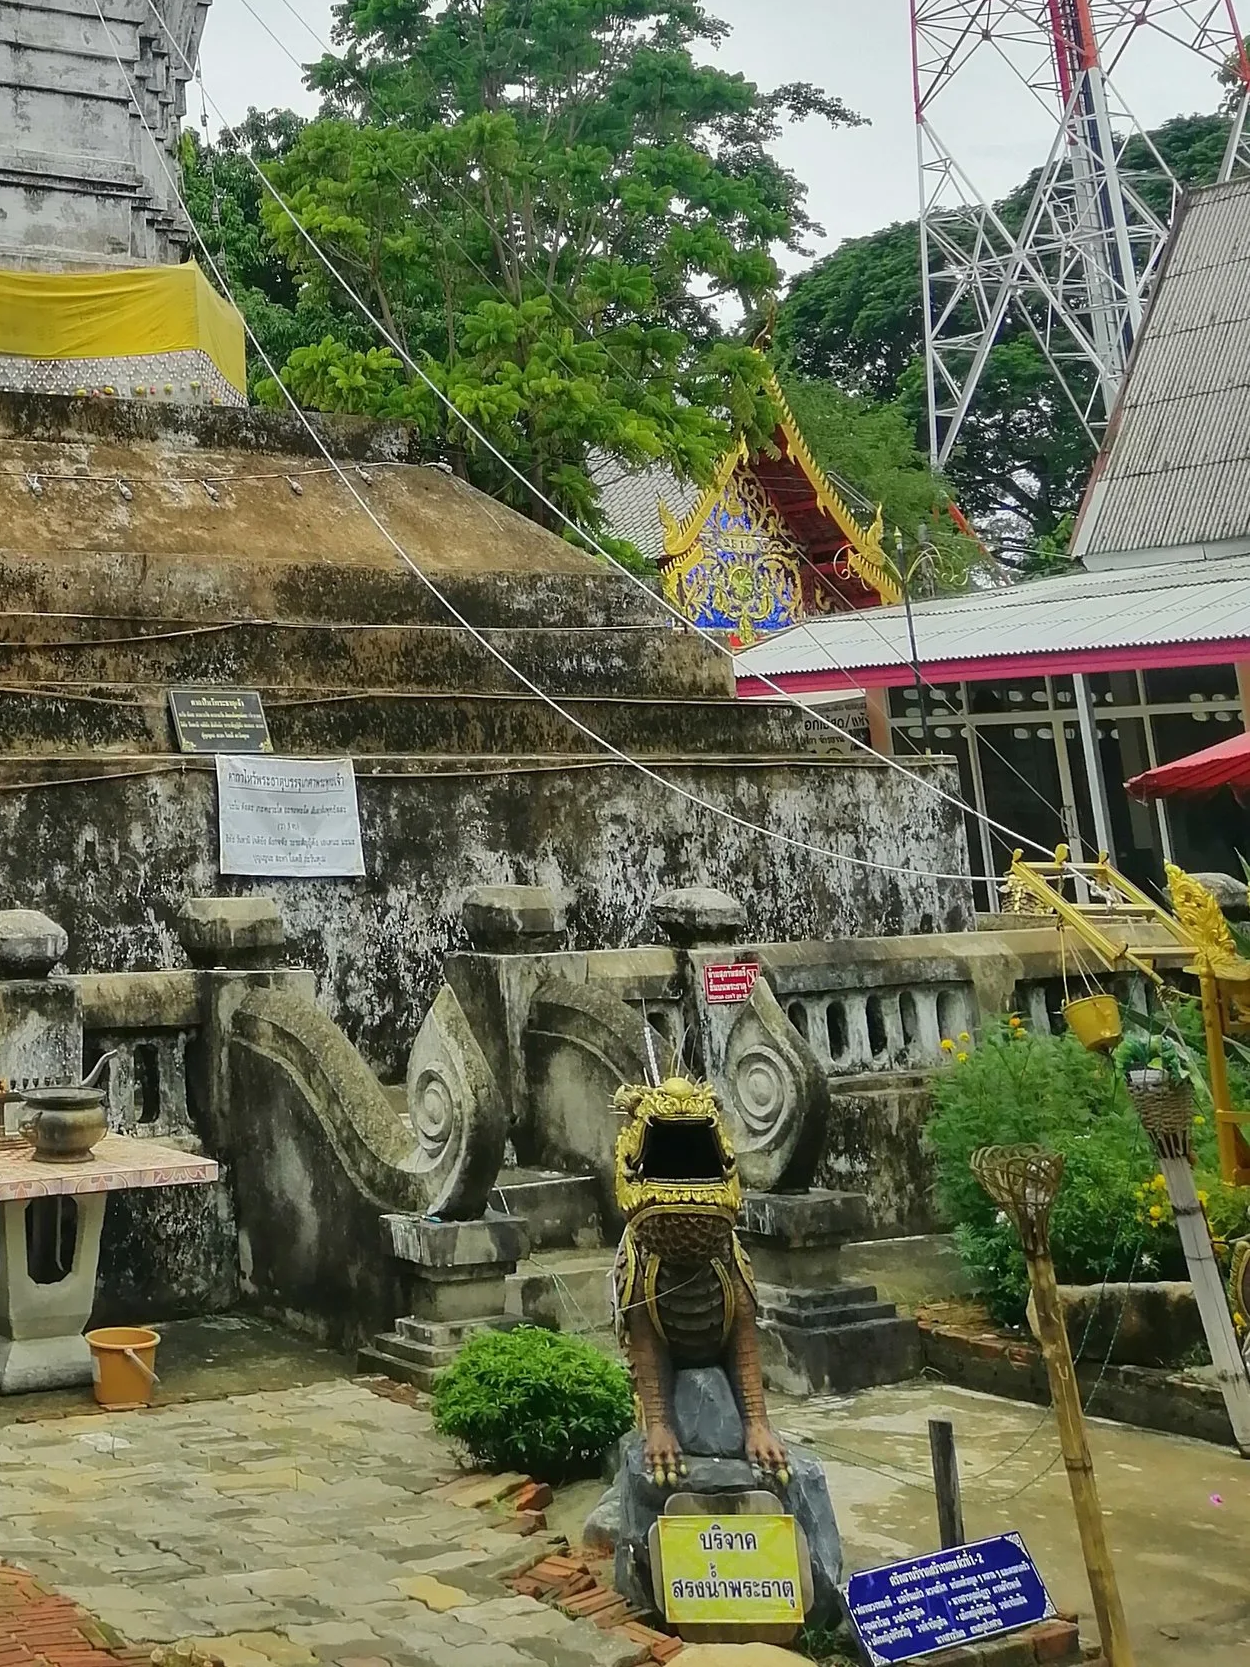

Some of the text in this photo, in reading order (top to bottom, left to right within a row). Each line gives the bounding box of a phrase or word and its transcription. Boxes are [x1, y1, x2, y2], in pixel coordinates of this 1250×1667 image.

[699, 1524, 757, 1550] บริจาค
[672, 1563, 796, 1608] สรงน้ำพระธาตุ
